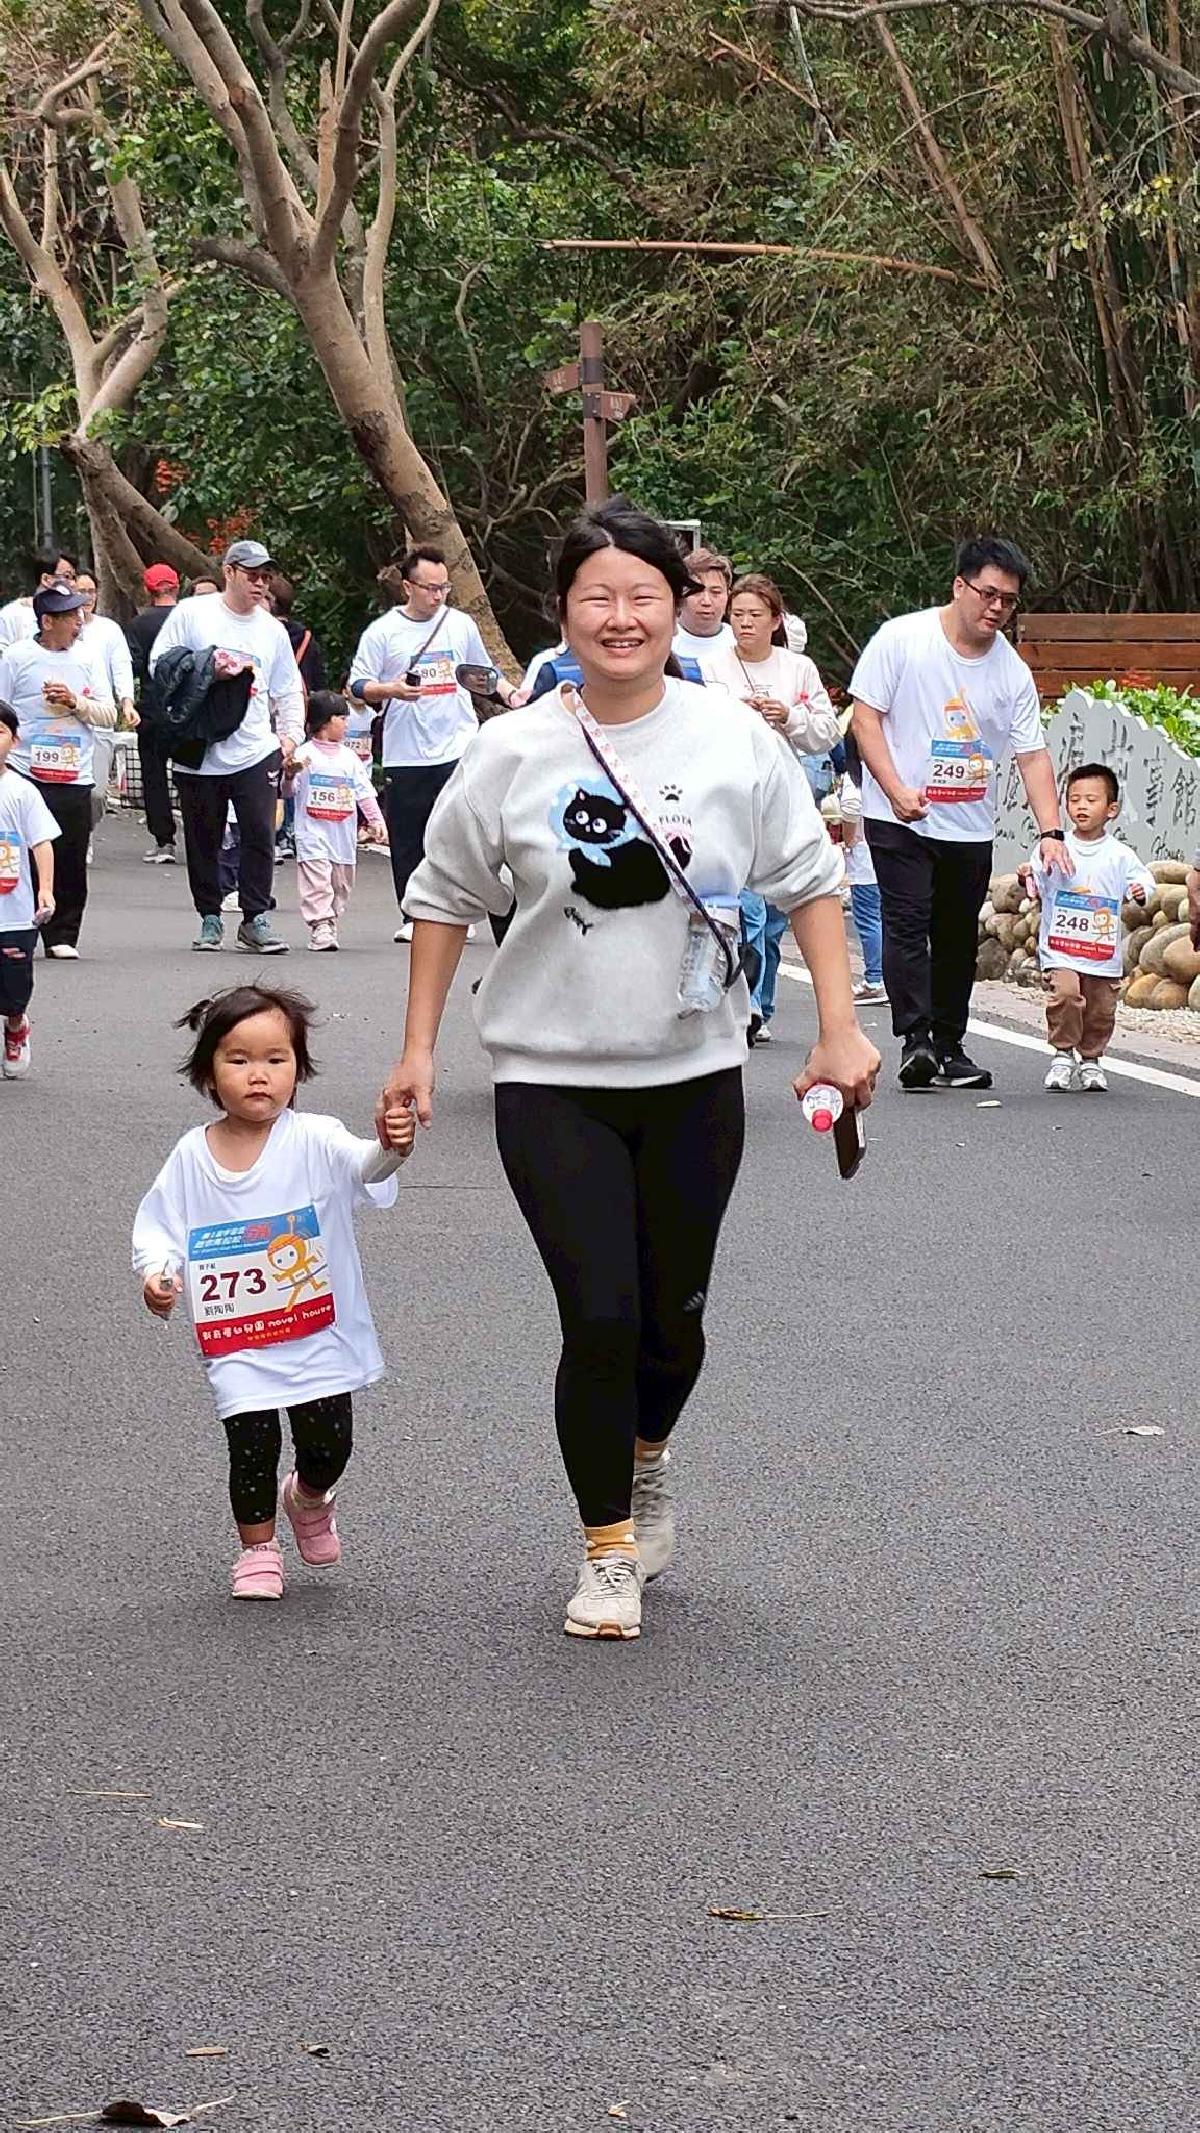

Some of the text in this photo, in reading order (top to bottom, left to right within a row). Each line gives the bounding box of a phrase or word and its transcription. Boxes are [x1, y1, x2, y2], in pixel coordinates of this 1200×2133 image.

[35, 750, 59, 763] 199
[933, 764, 965, 779] 249
[312, 790, 335, 802] 156
[1056, 914, 1089, 932] 248
[200, 1268, 267, 1302] 273
[268, 1313, 298, 1328] novel
[302, 1304, 332, 1320] house
